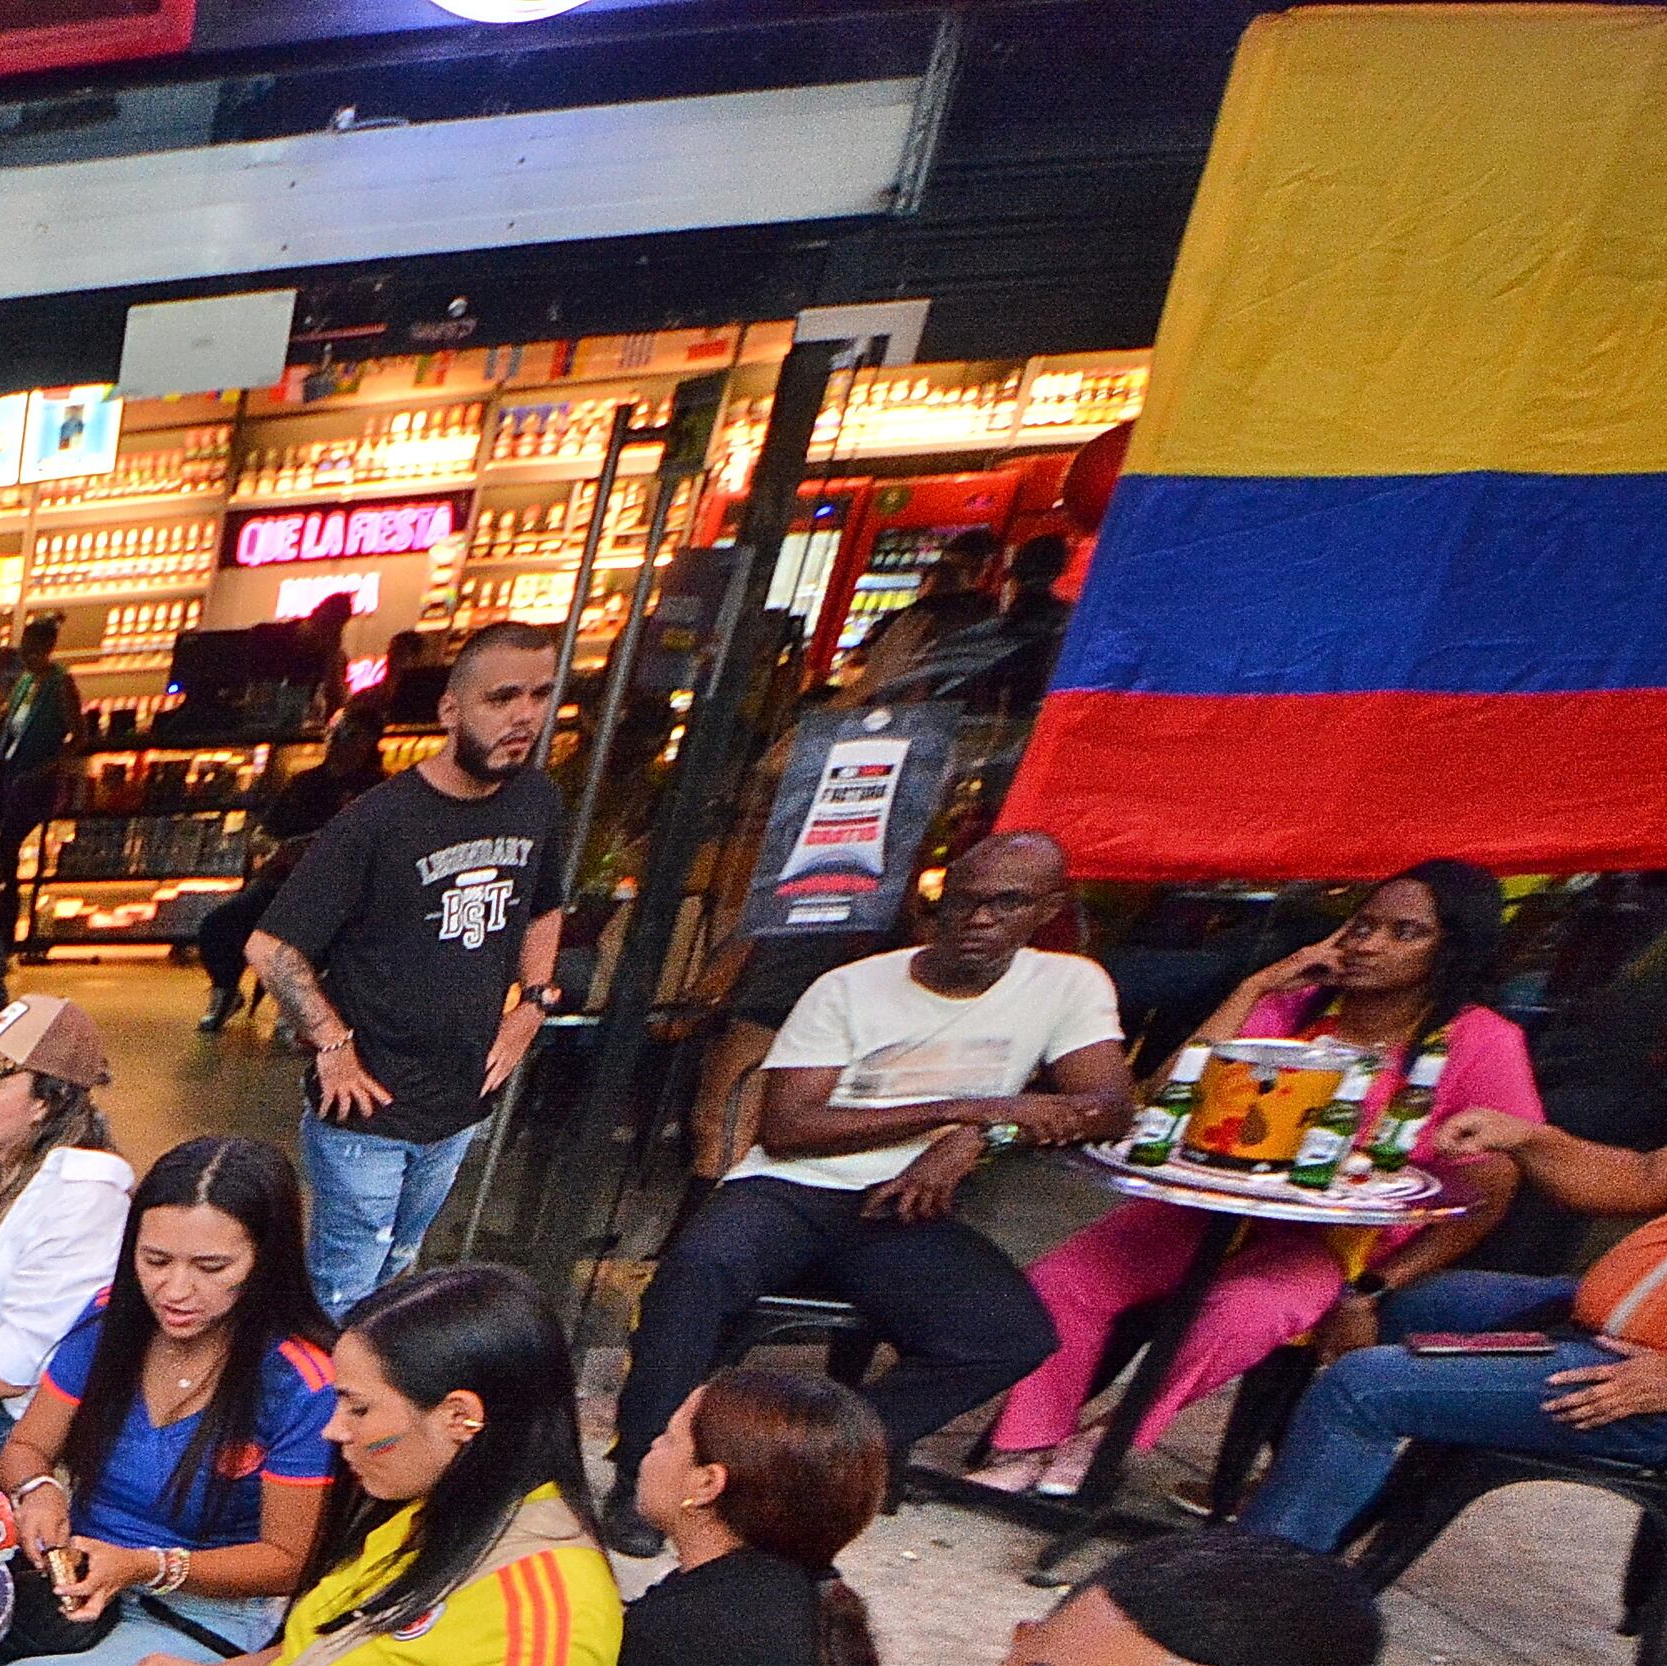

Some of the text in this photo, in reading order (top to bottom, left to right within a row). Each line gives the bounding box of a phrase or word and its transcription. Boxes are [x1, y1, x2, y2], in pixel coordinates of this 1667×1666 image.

[237, 500, 454, 567] QUE LA FIESTA
